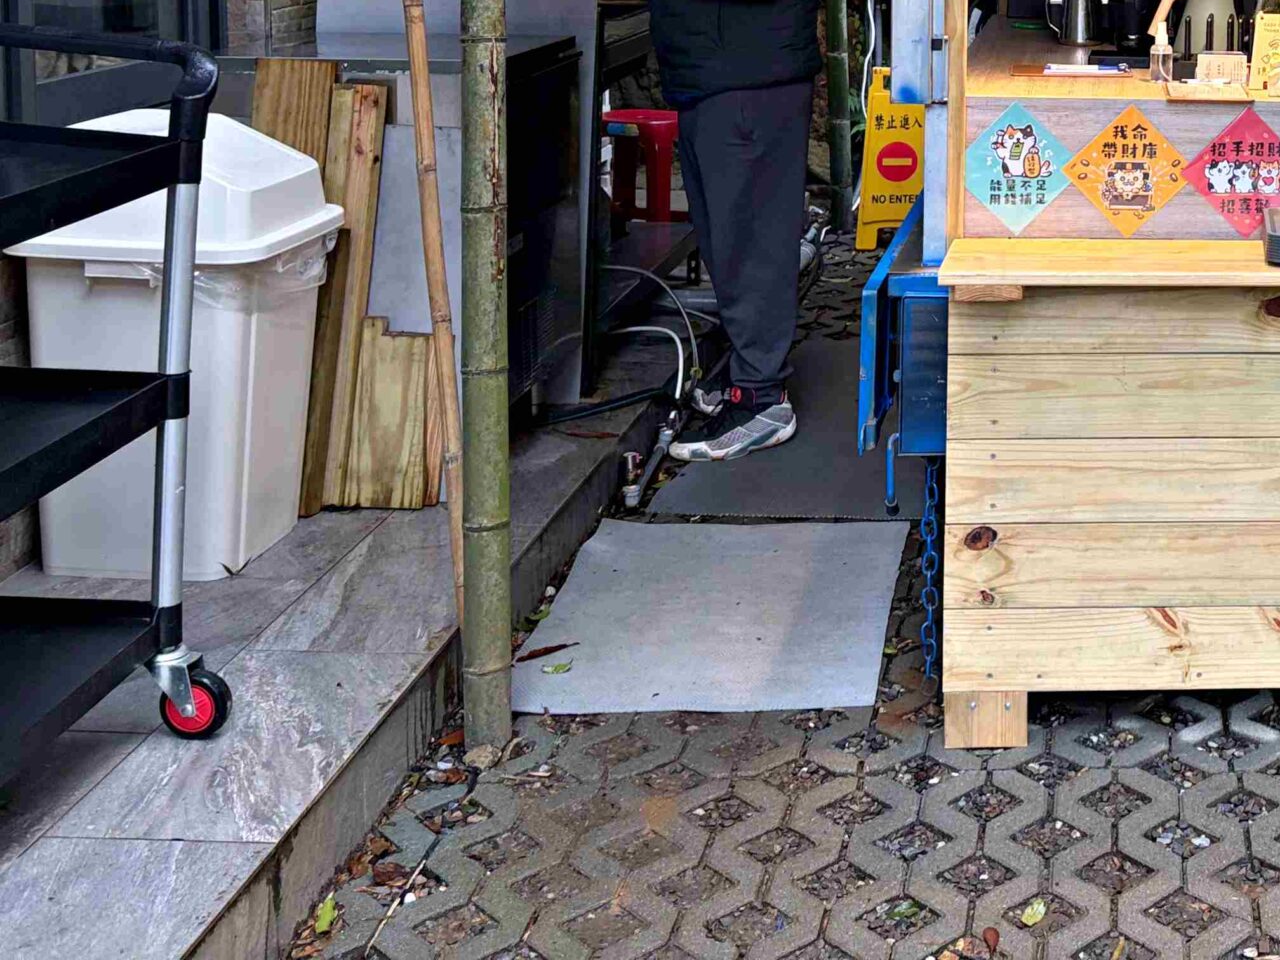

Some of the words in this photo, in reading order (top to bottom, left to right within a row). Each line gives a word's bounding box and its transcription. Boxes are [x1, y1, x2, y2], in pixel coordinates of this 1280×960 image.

[874, 113, 923, 131] 禁止進入
[1112, 123, 1149, 141] 我命
[1101, 141, 1158, 160] 帶財庫
[990, 179, 1047, 192] 能量不足
[871, 194, 887, 204] NO
